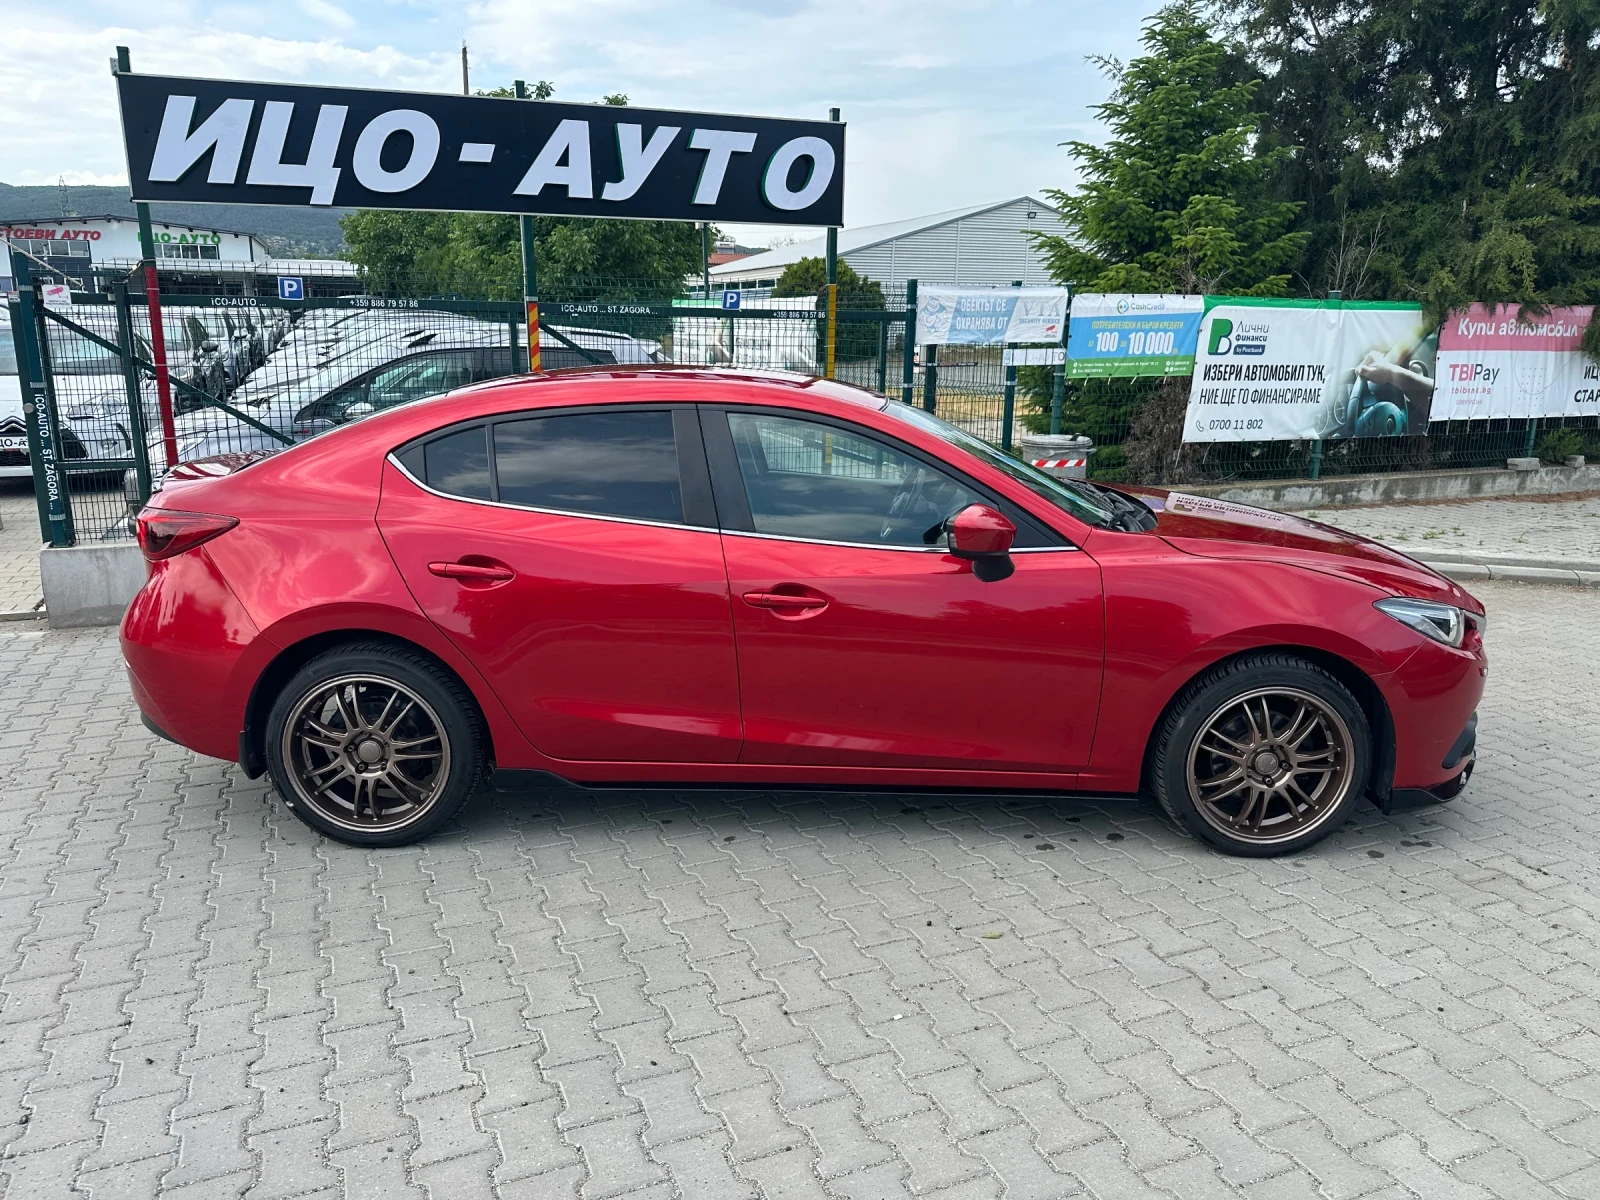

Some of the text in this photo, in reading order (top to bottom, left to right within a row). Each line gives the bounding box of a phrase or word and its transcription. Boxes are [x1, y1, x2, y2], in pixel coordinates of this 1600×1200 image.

[61, 229, 101, 241] АУТО
[137, 231, 221, 244] ЦО-АУТО
[283, 280, 298, 297] P
[349, 298, 419, 308] +359 886 79 57 86
[725, 293, 737, 308] P
[960, 298, 1006, 312] ОБЕКТЪТ СЕ
[1130, 302, 1165, 310] CashCredit
[619, 306, 651, 315] ZAGORA
[817, 311, 826, 319] 86
[1021, 300, 1061, 317] VTA
[956, 316, 1008, 330] ОХРАНЯВА ОТ
[1235, 320, 1270, 333] Лични
[1457, 317, 1578, 340] Купи автомобил
[1096, 331, 1119, 352] 100
[1203, 364, 1326, 384] ИЗБЕРИ АВТОМОБИЛ ТУК,
[1583, 365, 1600, 381] ИЦ
[1199, 387, 1321, 406] НИЕ ЩЕ ГО ФИНАНСИРАМЕ
[1451, 386, 1492, 395] tbibank.bg
[1209, 419, 1263, 430] 0700 11 802
[42, 448, 53, 461] ST.
[44, 463, 58, 501] ZAGORA
